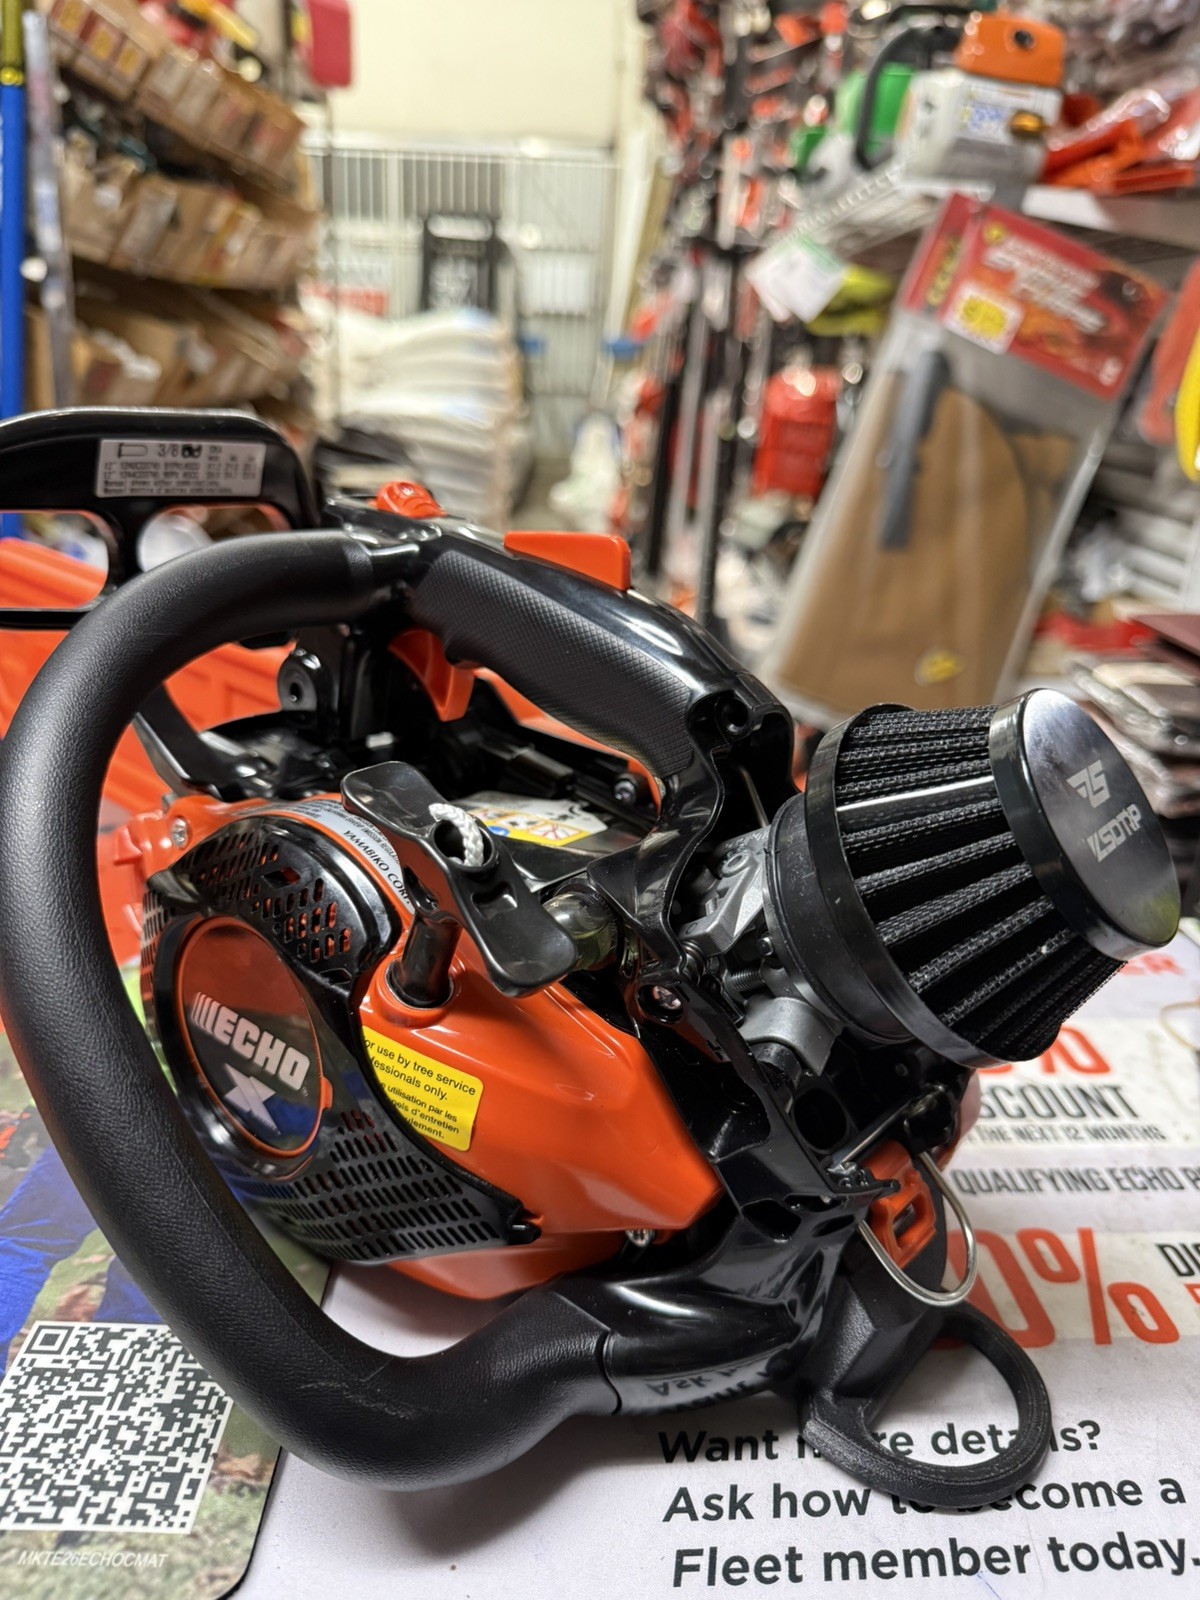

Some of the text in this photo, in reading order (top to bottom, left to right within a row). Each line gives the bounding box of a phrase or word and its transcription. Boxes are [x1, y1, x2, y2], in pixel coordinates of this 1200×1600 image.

[344, 830, 389, 871] YAMABIKO
[202, 998, 310, 1090] ECHO
[365, 1040, 476, 1095] or use by tree service
[388, 1083, 426, 1108] utilisation
[429, 1105, 443, 1115] par
[445, 1110, 457, 1122] les
[424, 1083, 448, 1100] only.
[411, 1108, 459, 1133] d'entretien
[1012, 1125, 1060, 1142] NEXT
[1061, 1125, 1084, 1141] 12
[1084, 1124, 1168, 1141] MONTHS
[951, 1168, 1109, 1195] QUALIFYING
[1104, 1167, 1185, 1192] ECHO
[658, 1430, 778, 1463] Want
[662, 1484, 755, 1522] Ask
[772, 1483, 871, 1518] how
[1158, 1478, 1187, 1503] a
[16, 1550, 169, 1568] MKTE26ECHOCMAT
[673, 1546, 803, 1588] Fleet
[823, 1538, 1031, 1581] member
